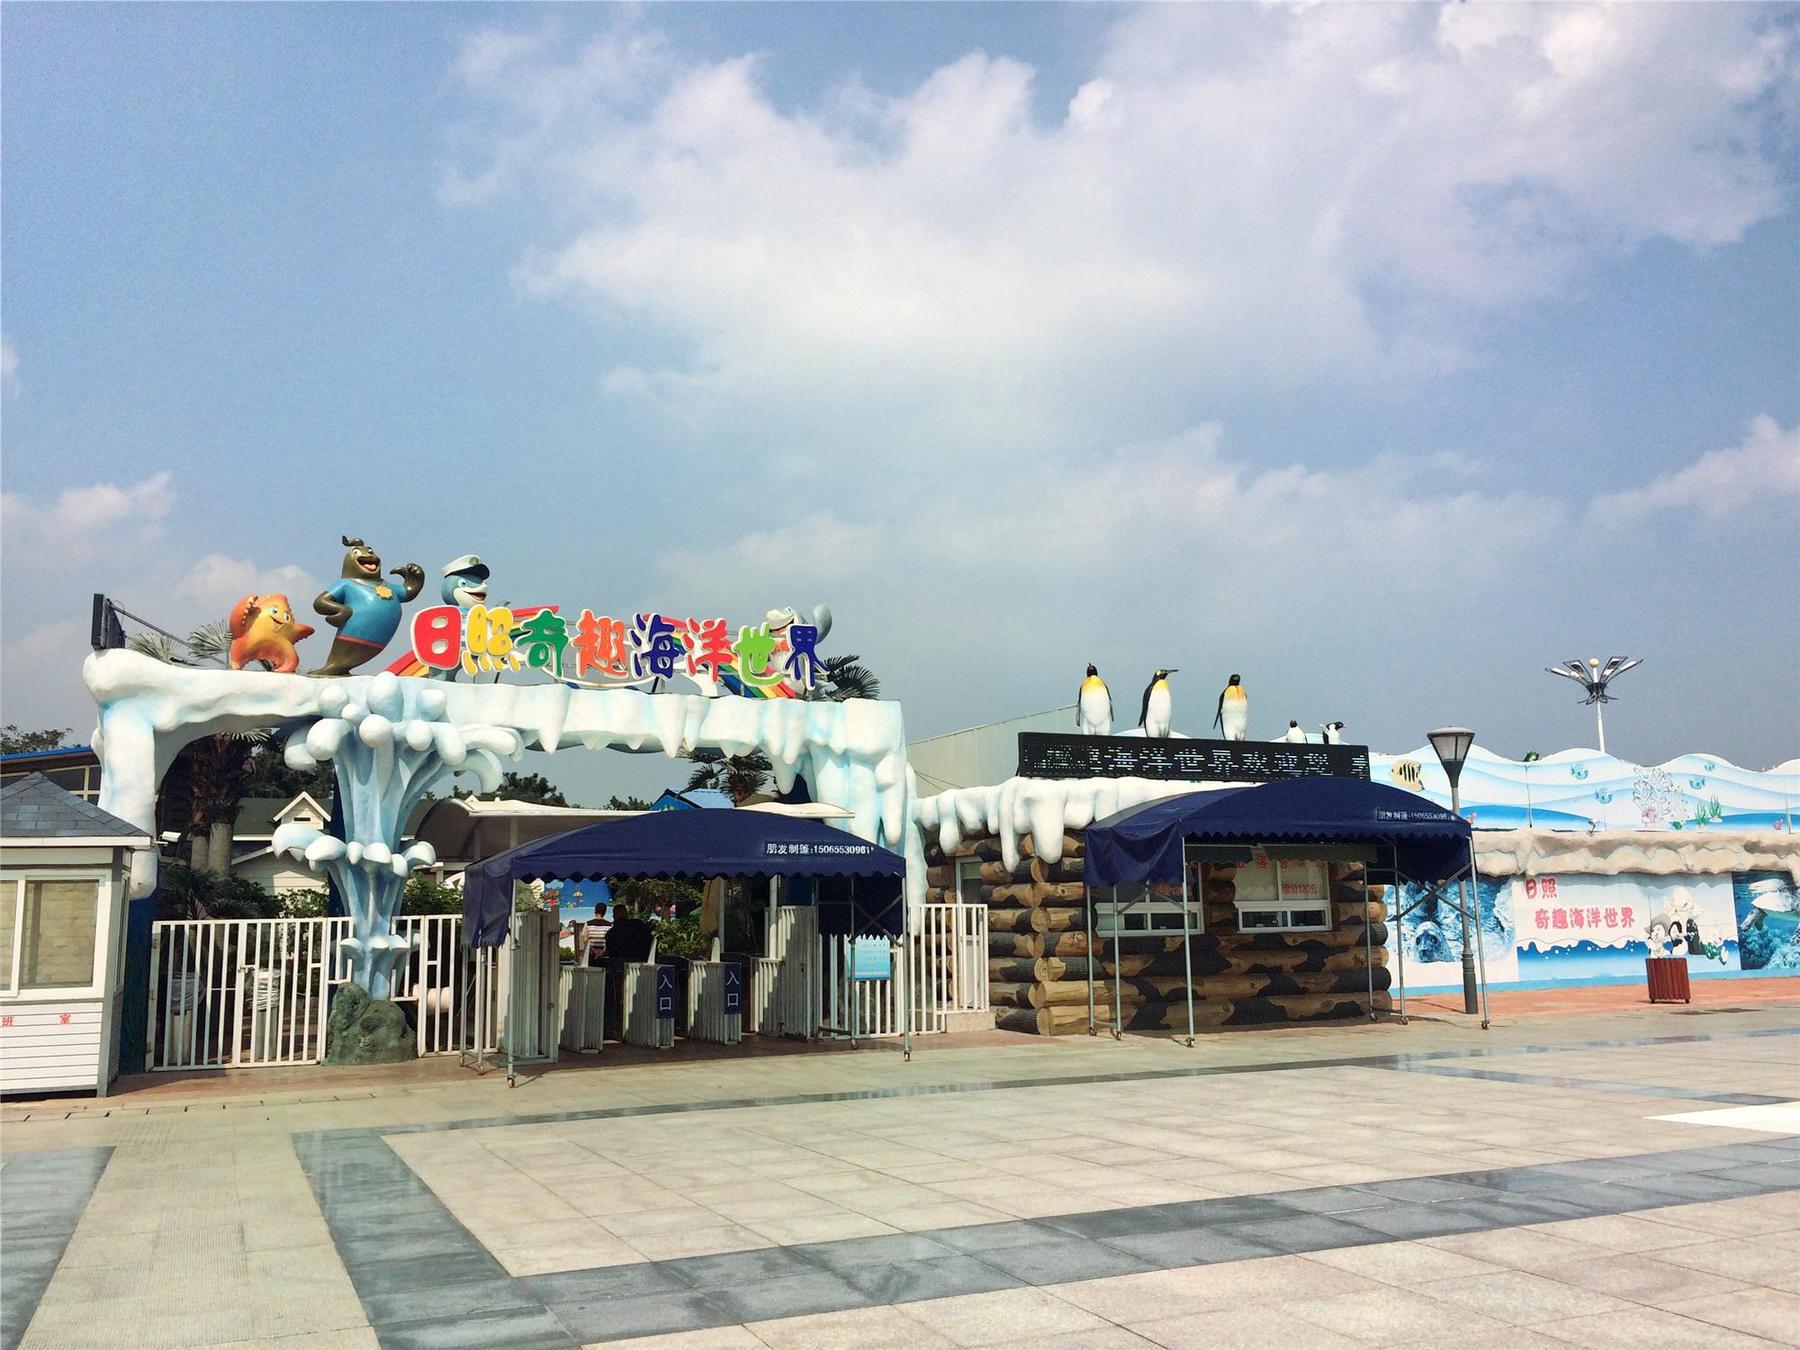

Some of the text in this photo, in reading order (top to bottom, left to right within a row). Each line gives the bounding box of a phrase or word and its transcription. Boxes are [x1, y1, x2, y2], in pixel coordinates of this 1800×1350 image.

[411, 604, 831, 692] 日照奇趣海洋世界
[1525, 878, 1558, 899] 日照
[1535, 907, 1635, 930] 奇趣海洋世界
[659, 974, 673, 1012] 入口
[726, 971, 740, 1008] 入口
